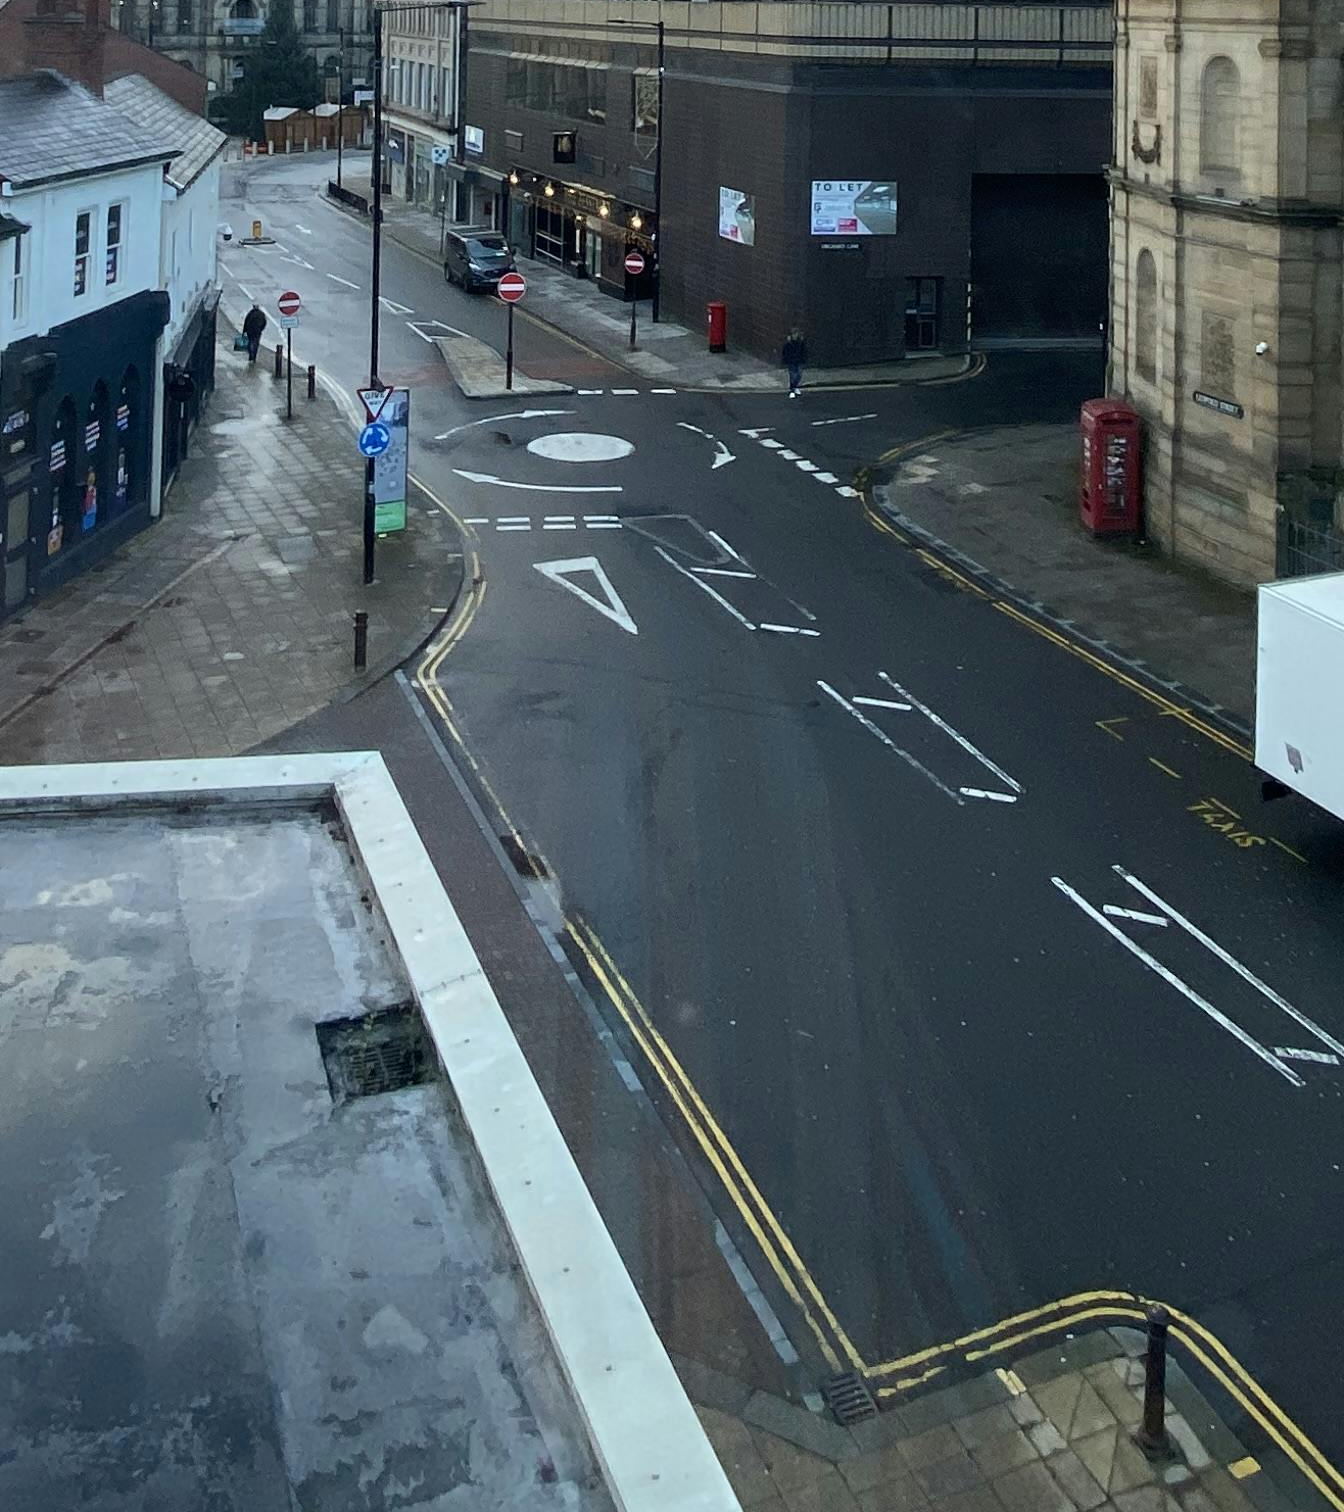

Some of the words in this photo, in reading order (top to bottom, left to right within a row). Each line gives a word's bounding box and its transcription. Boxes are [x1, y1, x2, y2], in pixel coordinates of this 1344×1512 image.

[815, 182, 832, 192] TO
[839, 183, 863, 192] LET
[1186, 799, 1267, 848] TAXIS
